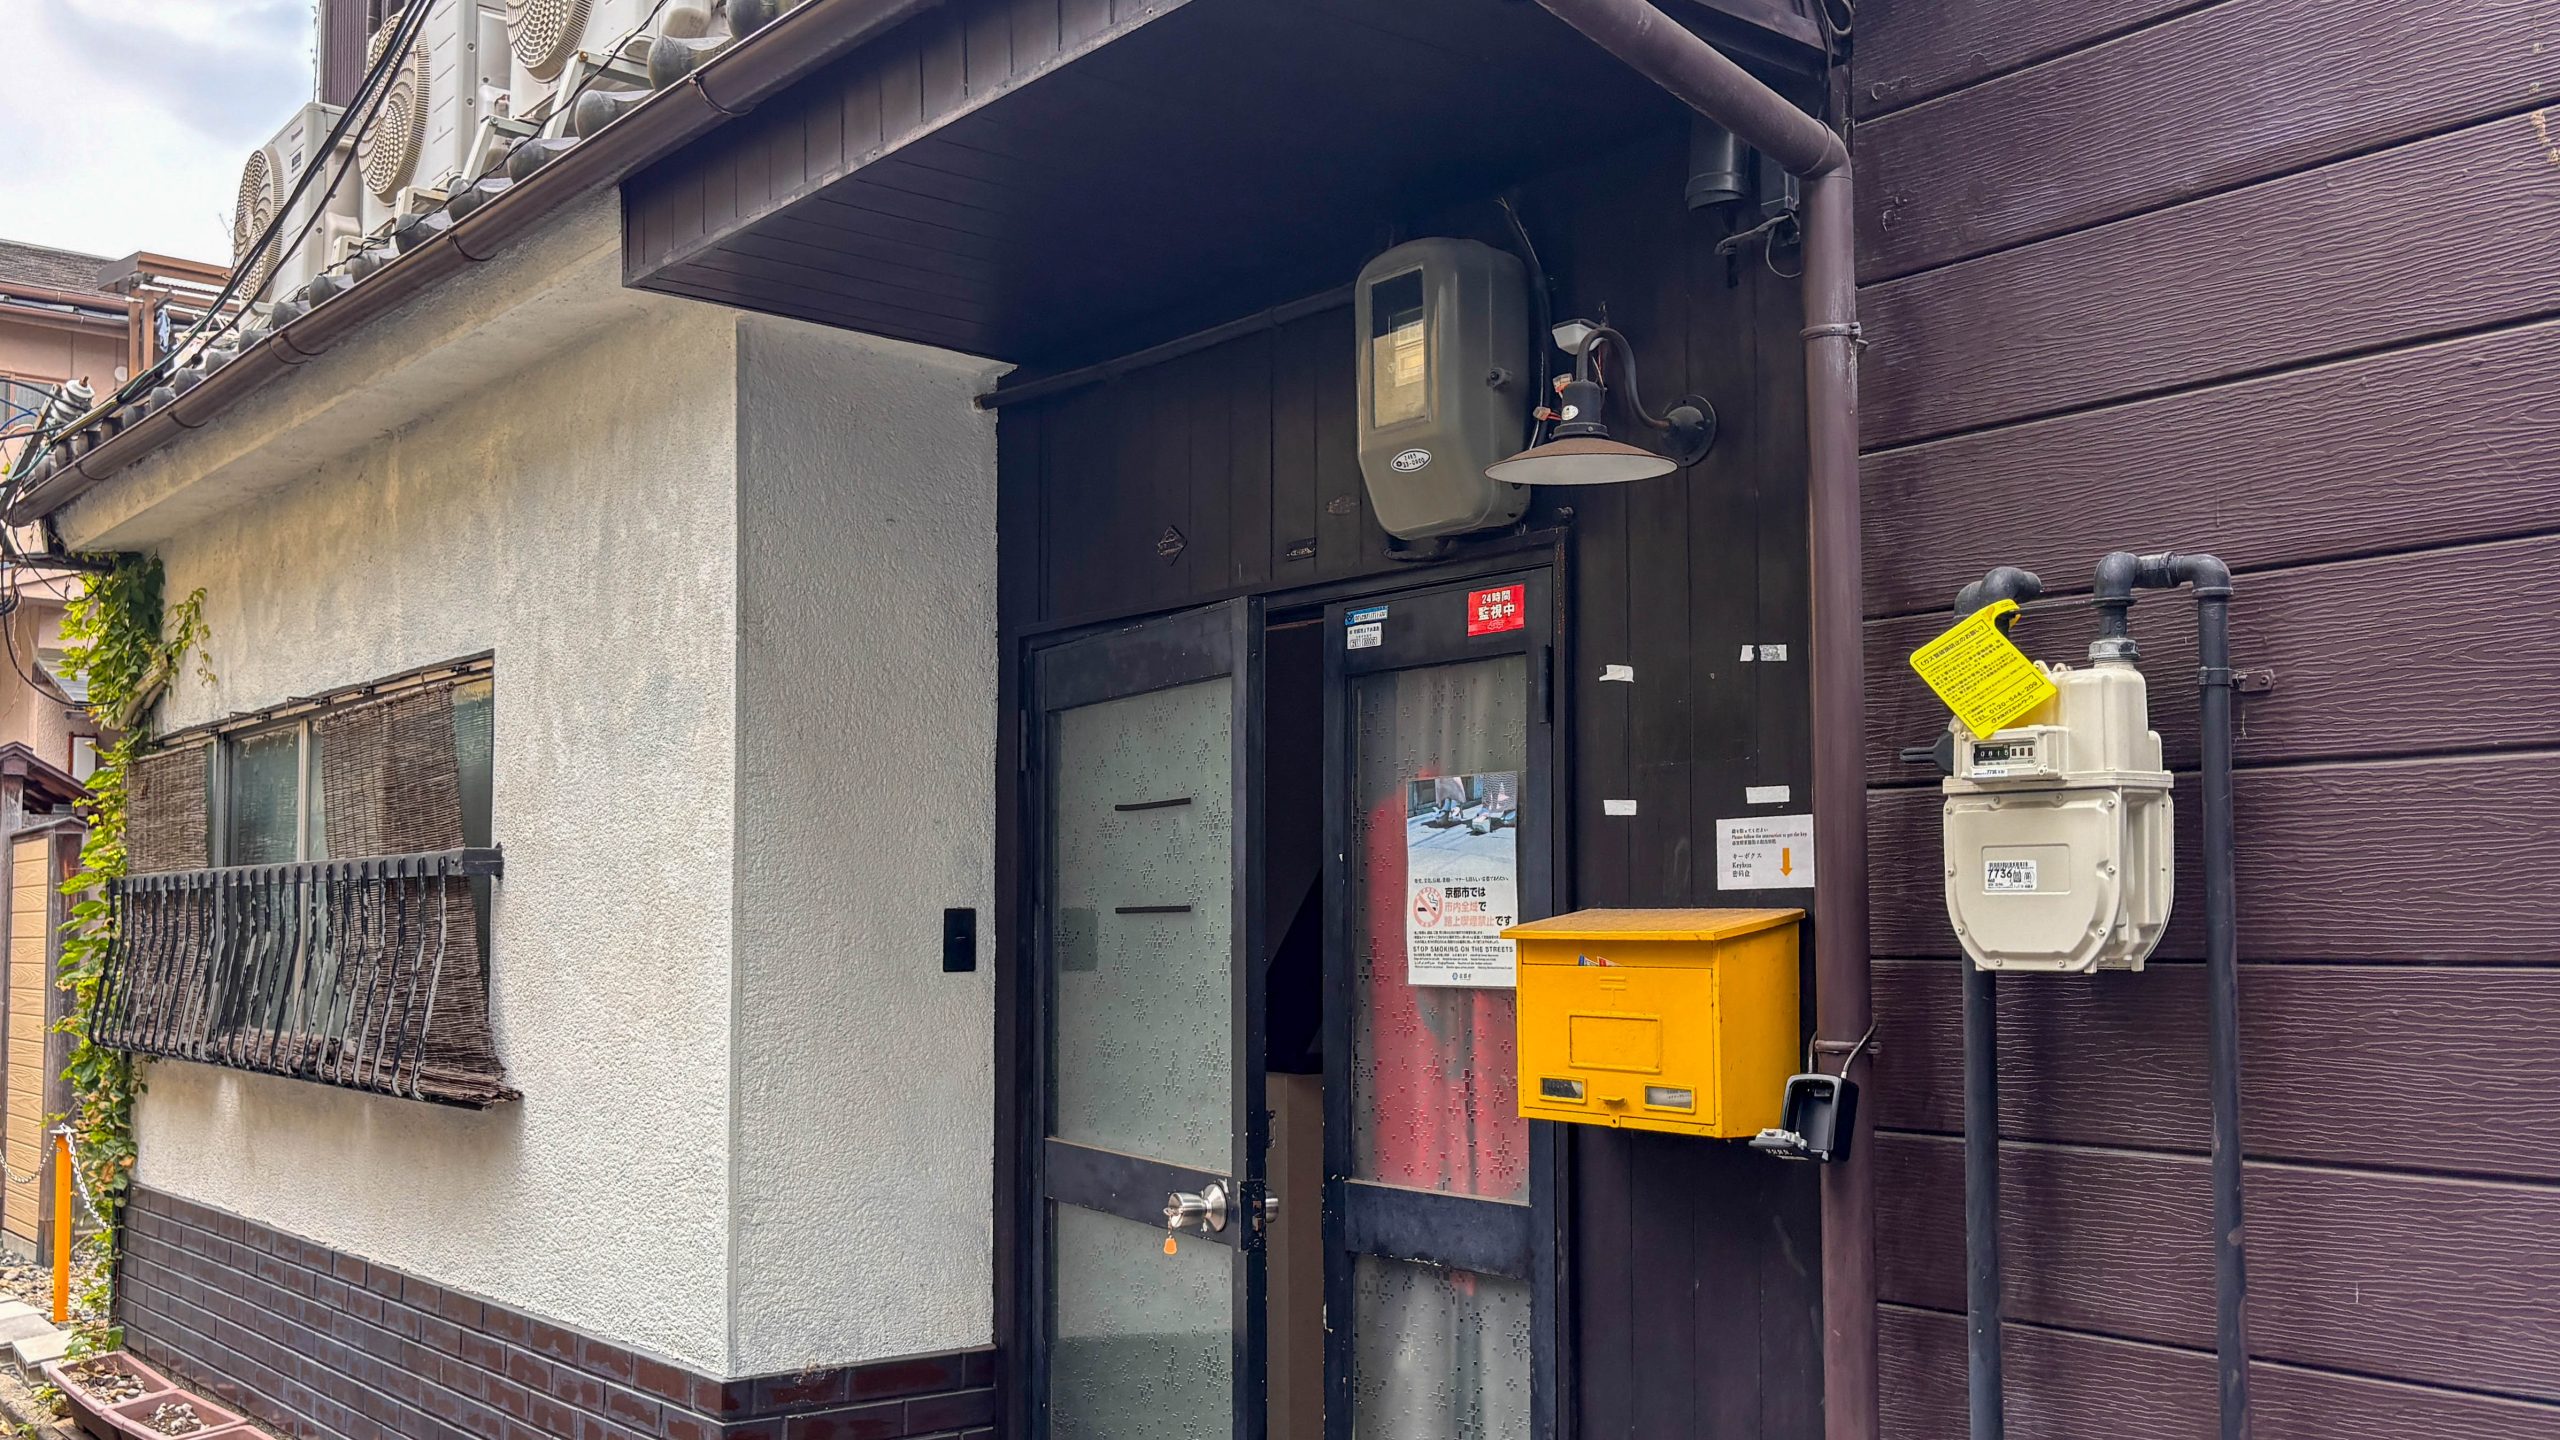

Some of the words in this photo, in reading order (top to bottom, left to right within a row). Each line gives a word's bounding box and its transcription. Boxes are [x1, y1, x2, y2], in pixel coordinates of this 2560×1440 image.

[1481, 590, 1511, 604] 24時間
[1478, 602, 1515, 621] 監視中
[1987, 867, 2013, 879] 7736
[1445, 887, 1486, 899] 京都市では
[1445, 901, 1487, 913] 市内全域で
